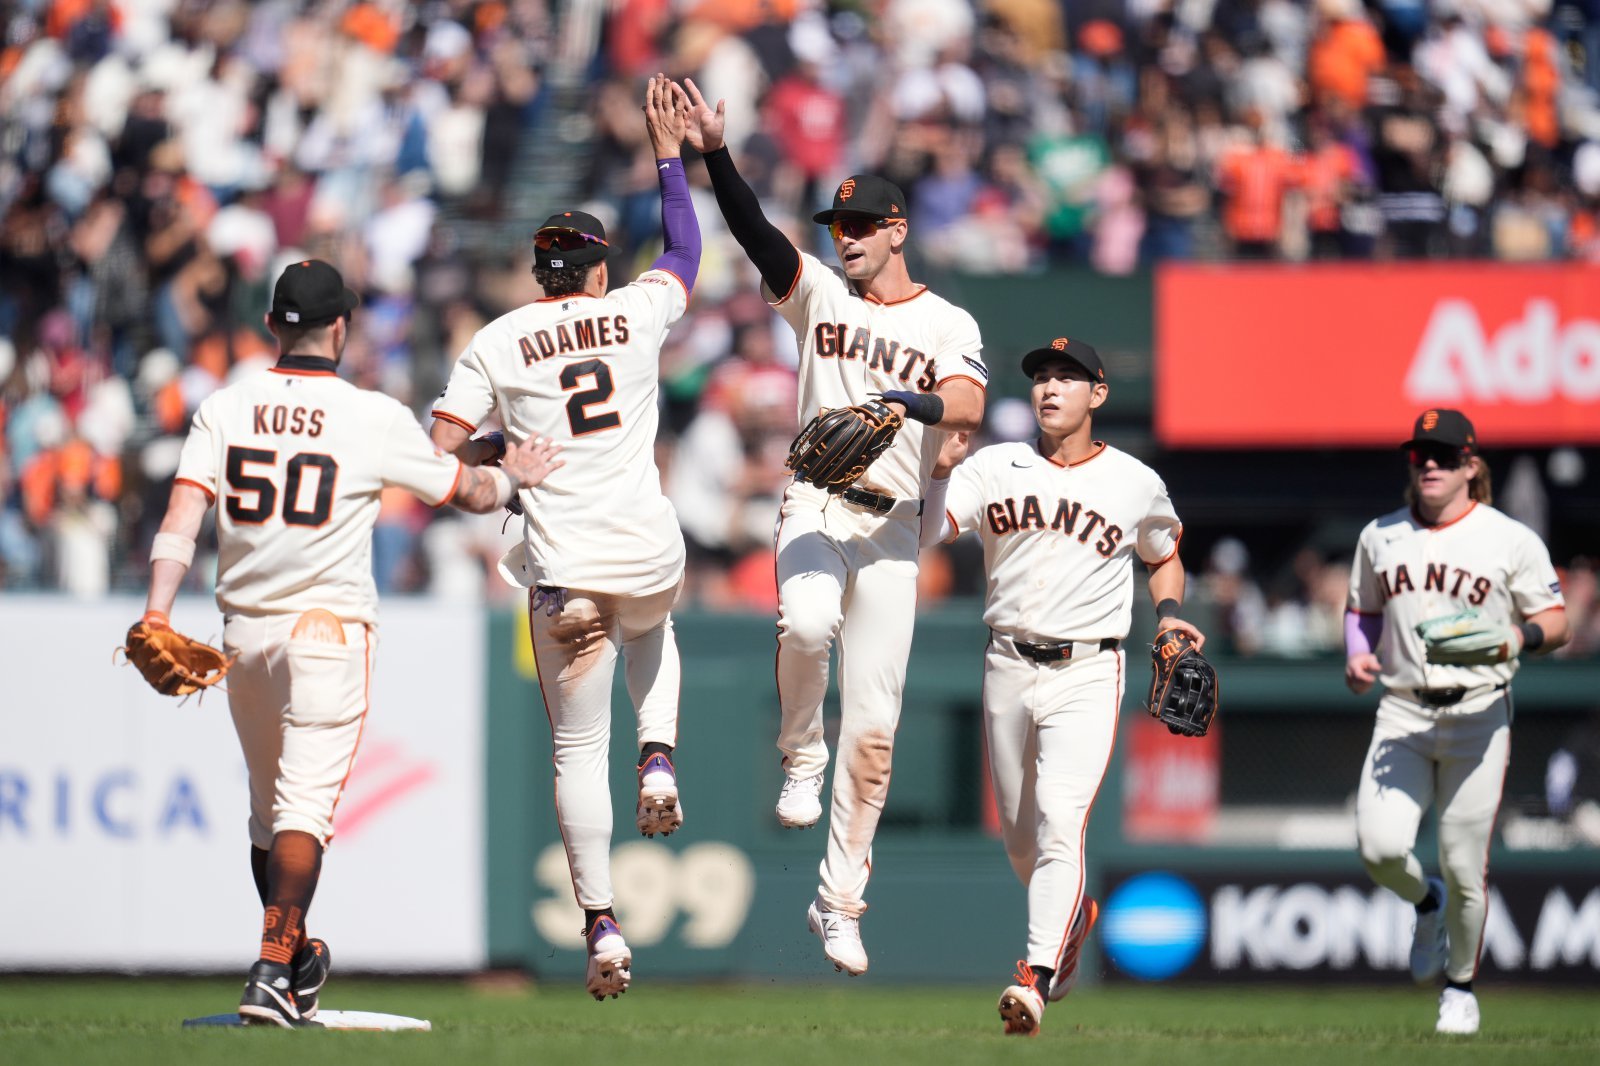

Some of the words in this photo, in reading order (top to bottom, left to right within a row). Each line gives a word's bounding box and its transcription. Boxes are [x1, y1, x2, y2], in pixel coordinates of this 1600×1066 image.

[518, 314, 629, 369] ADAMES
[815, 321, 937, 393] GIANTS
[1404, 297, 1600, 403] Ado
[253, 404, 325, 438] KOSS
[558, 357, 623, 438] 2
[226, 445, 339, 530] 50
[987, 495, 1123, 559] GIANTS
[1379, 562, 1492, 606] IANTS
[1211, 882, 1526, 970] KONIA
